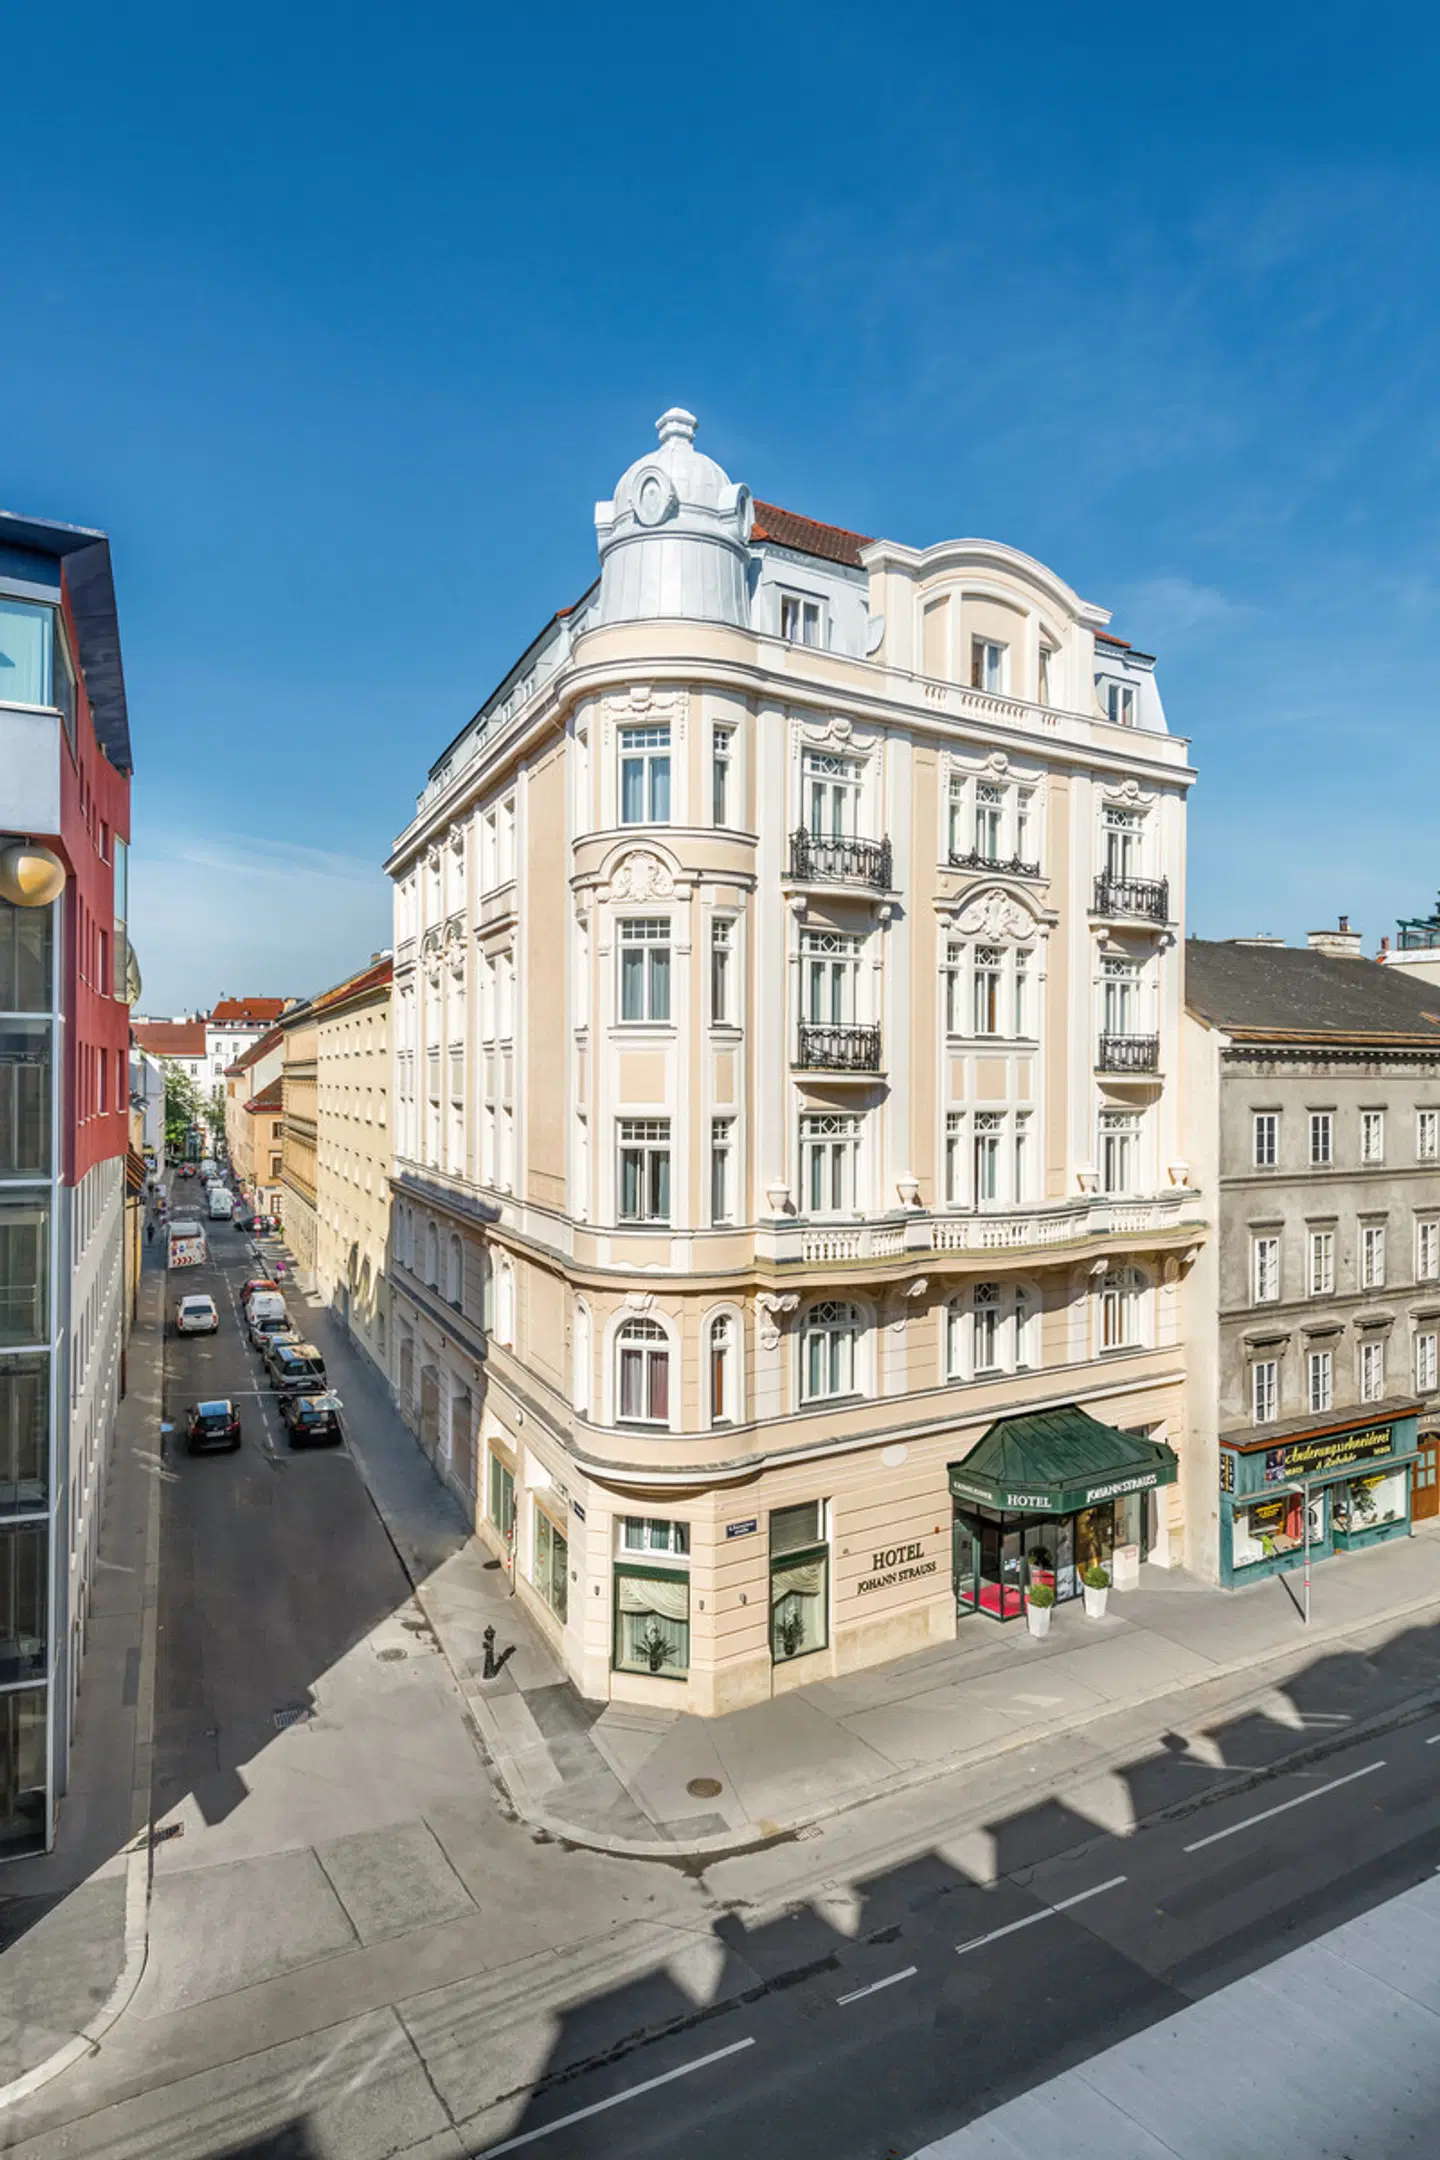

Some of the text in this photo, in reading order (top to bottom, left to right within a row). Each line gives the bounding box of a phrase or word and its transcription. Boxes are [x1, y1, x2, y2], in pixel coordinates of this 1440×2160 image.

[1007, 1494, 1052, 1508] HOTEL
[872, 1543, 924, 1570] HOTEL
[857, 1560, 937, 1595] JOHANN STRAUSS
